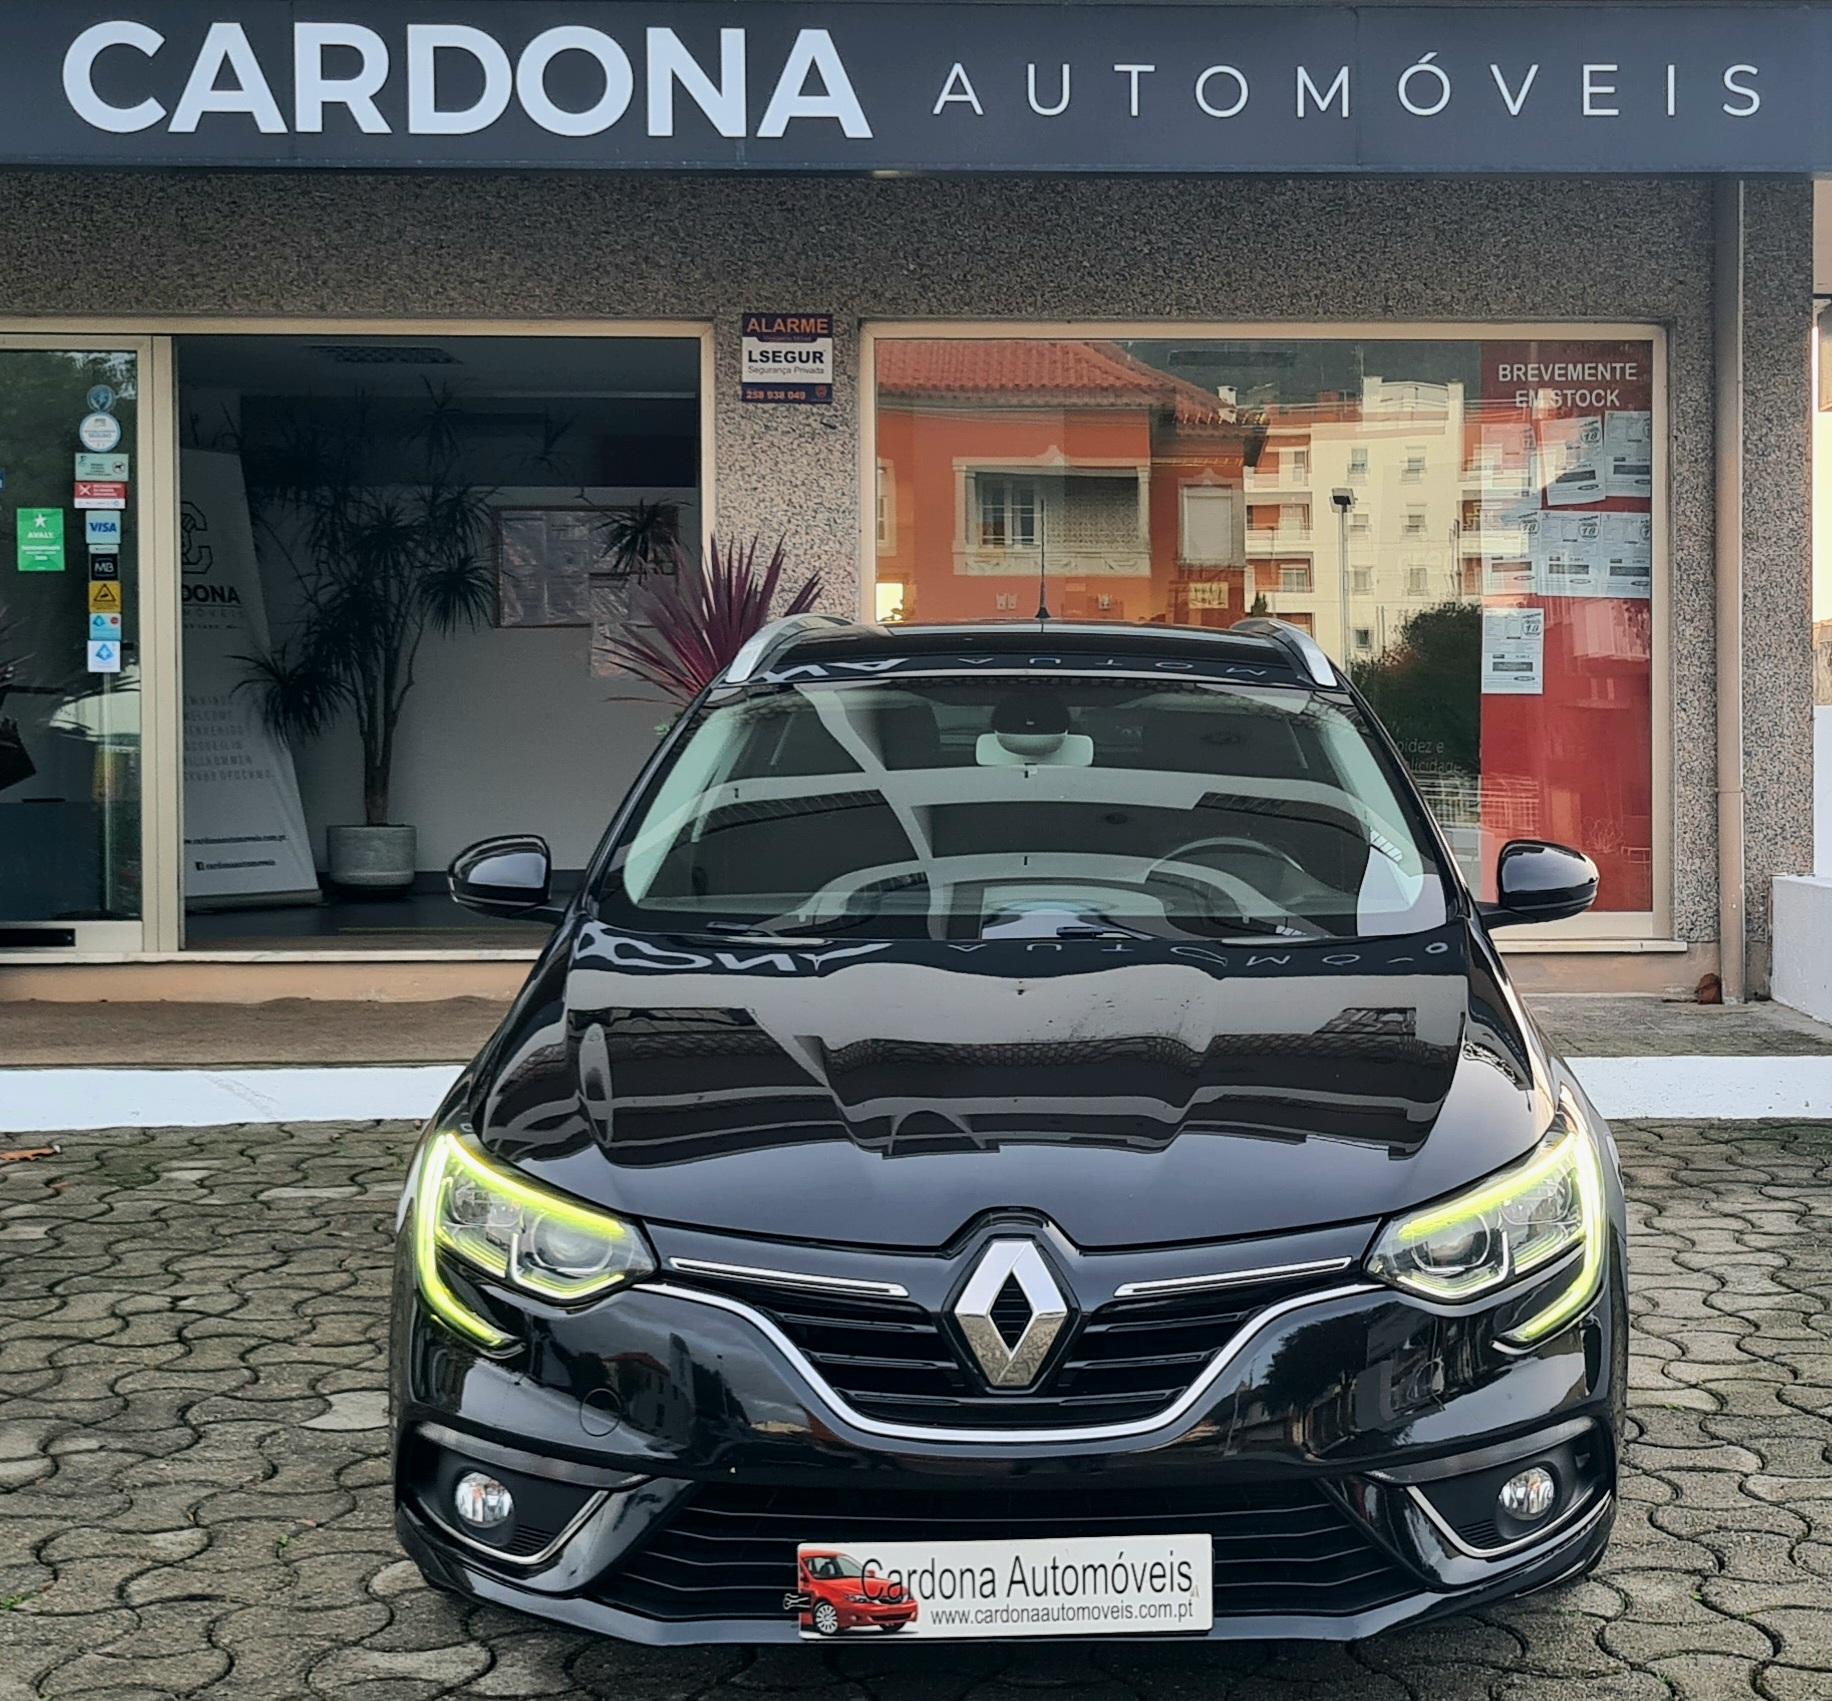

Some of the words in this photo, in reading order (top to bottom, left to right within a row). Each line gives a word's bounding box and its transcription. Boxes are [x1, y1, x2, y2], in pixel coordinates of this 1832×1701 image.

[63, 20, 873, 138] CARDONA
[932, 52, 1762, 118] AUTOMÓVEIS
[747, 317, 829, 333] ALARME
[747, 350, 825, 364] LSEGUR
[748, 366, 792, 375] Segurança
[794, 366, 824, 374] Privada
[1498, 363, 1638, 381] BREVEMENTE
[1516, 390, 1541, 408] EM
[1551, 389, 1620, 408] STOCK
[89, 522, 118, 532] VISA
[94, 562, 115, 573] MB
[860, 1557, 997, 1600] Cardona
[1006, 1550, 1193, 1598] Automóveis
[930, 1602, 1194, 1626] www.cardonaautomoveis.com.pt
